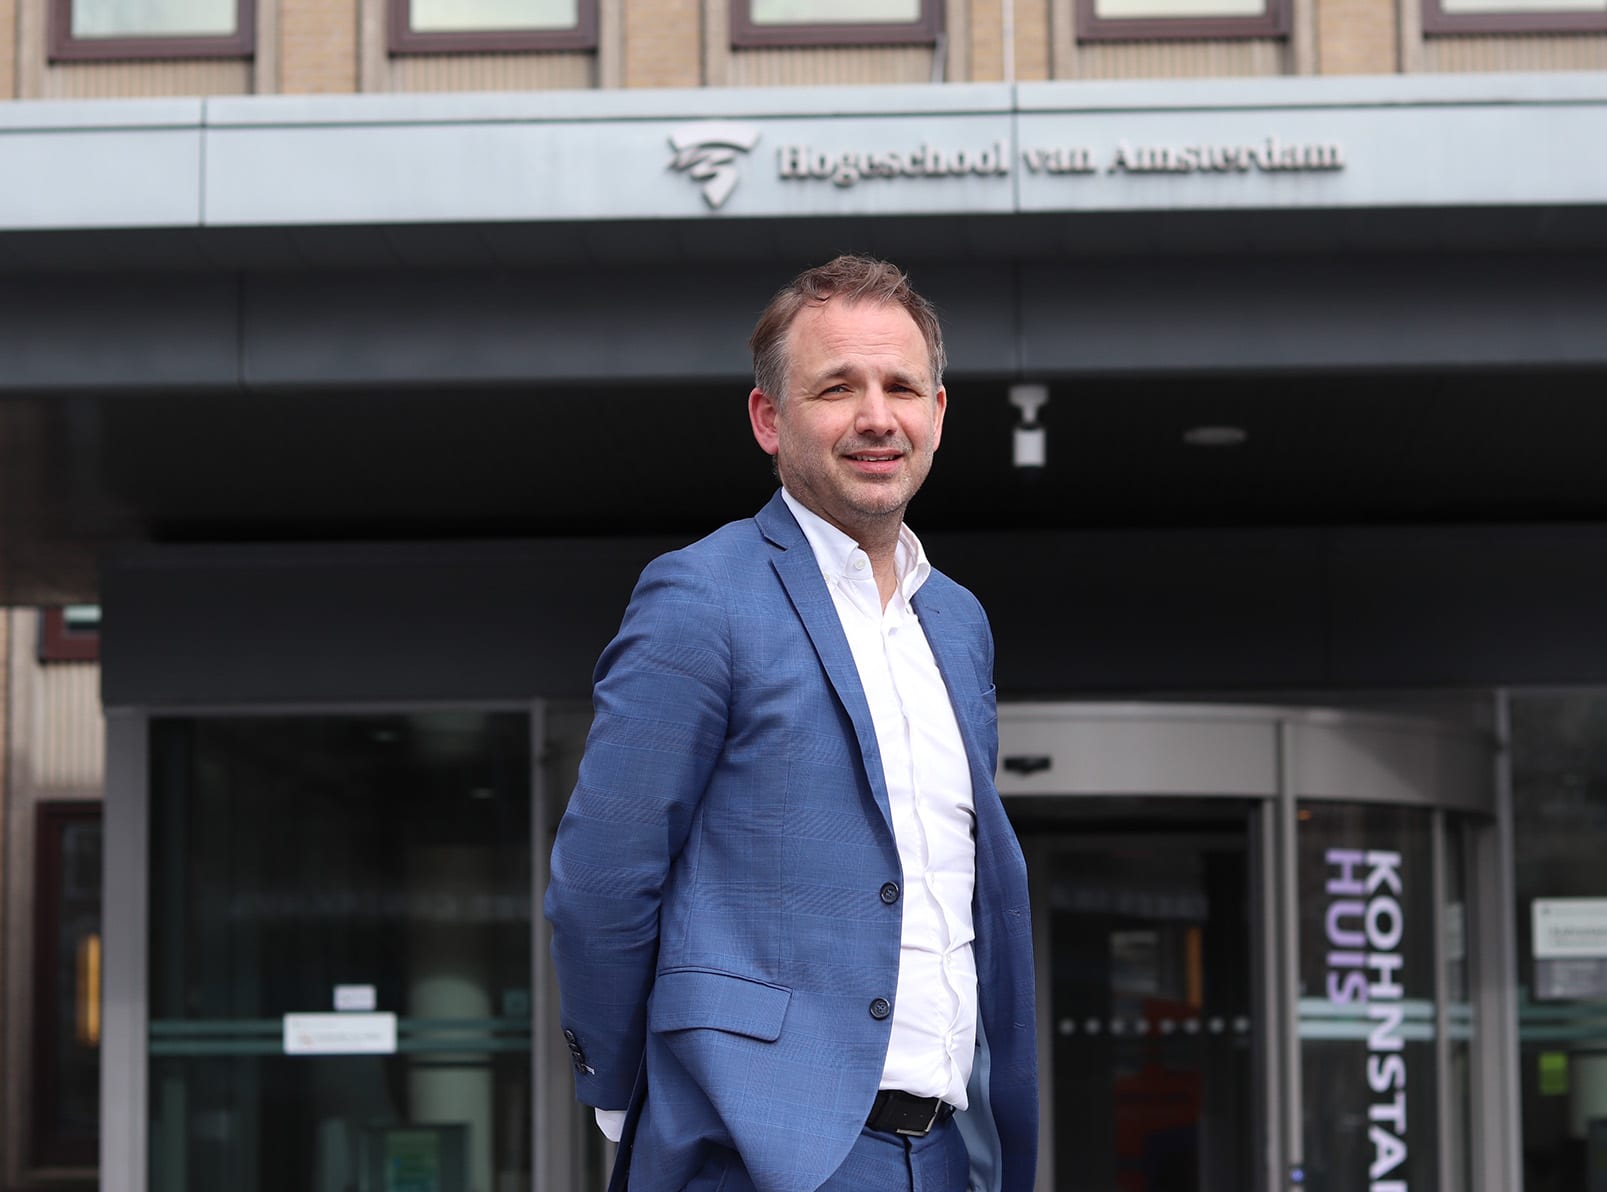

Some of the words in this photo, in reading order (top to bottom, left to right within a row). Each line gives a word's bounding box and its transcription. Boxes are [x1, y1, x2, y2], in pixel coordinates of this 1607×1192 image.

[777, 140, 1009, 187] Hogeschool
[1024, 146, 1096, 174] van
[1108, 134, 1344, 173] Amsterdam
[1326, 849, 1367, 1004] HUIS
